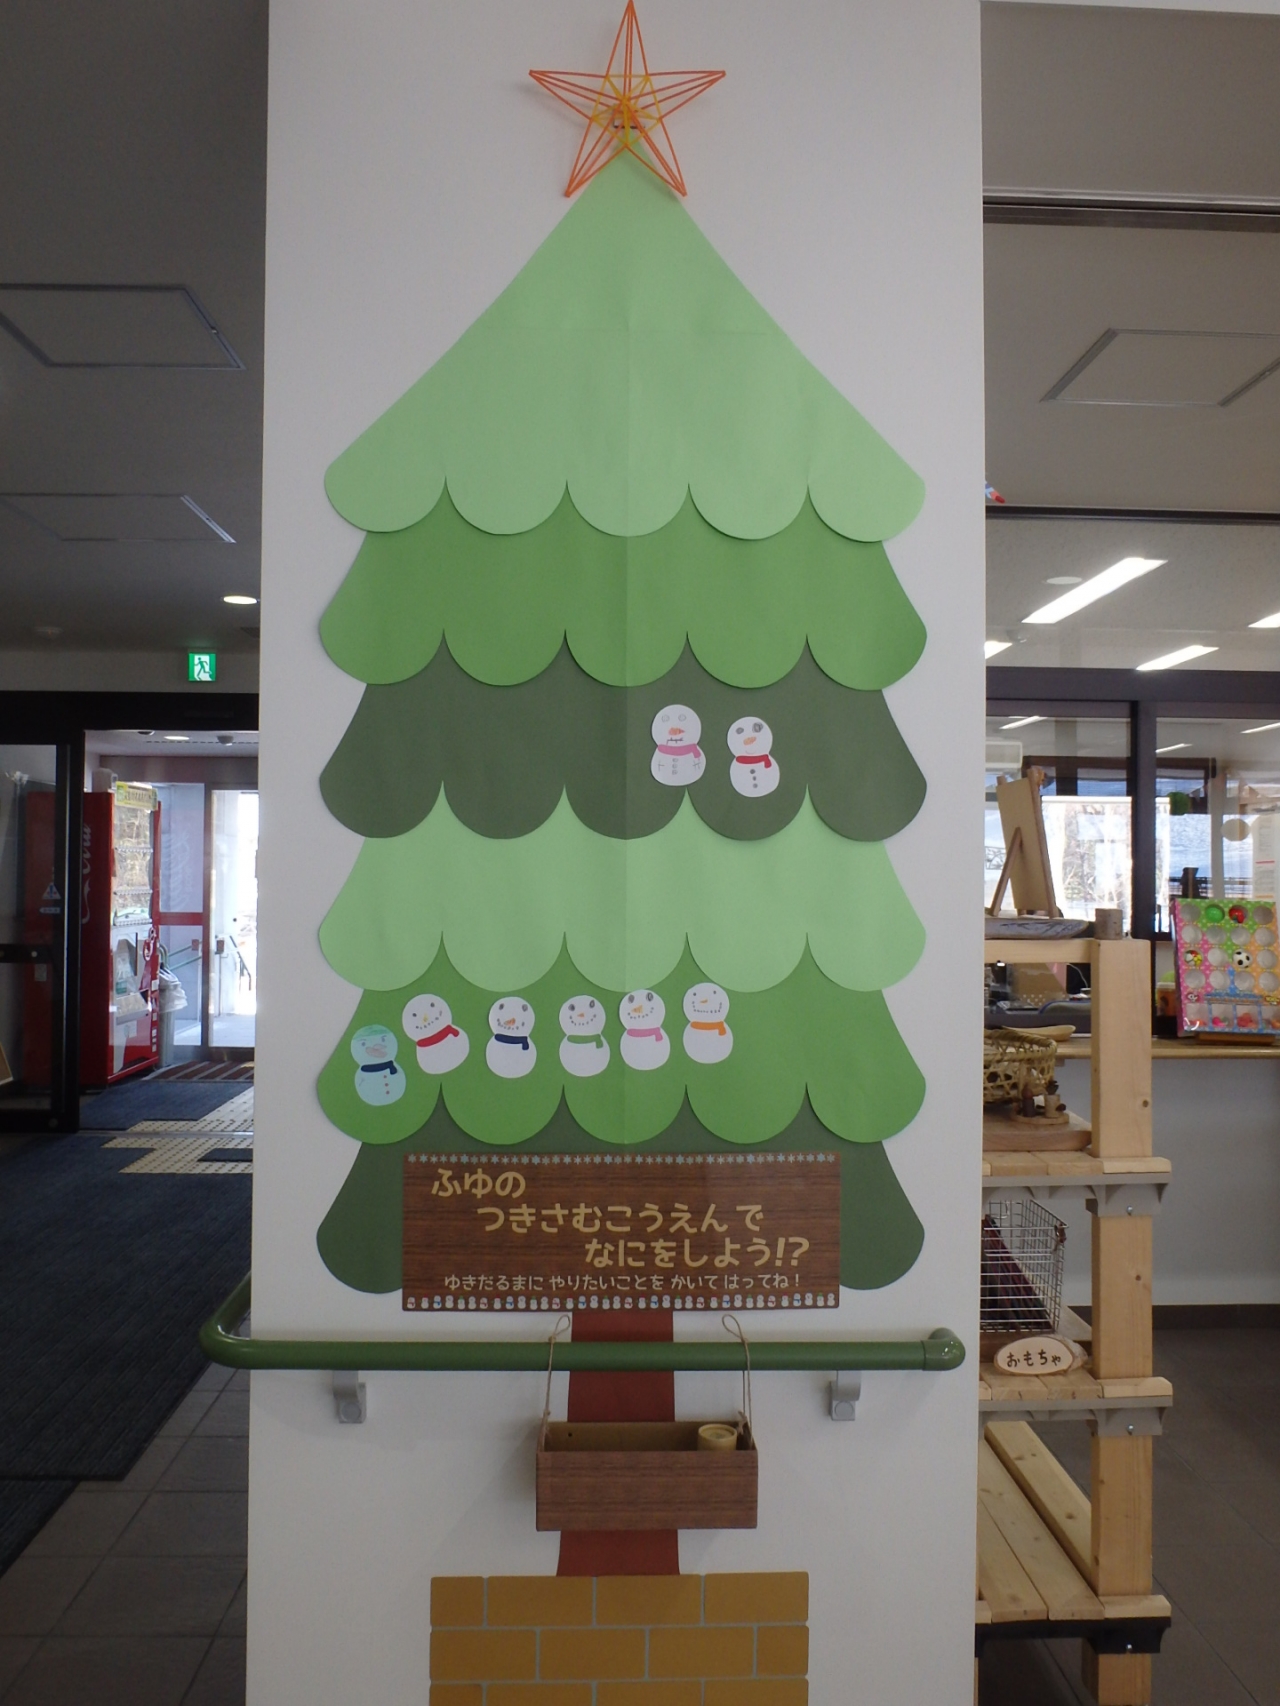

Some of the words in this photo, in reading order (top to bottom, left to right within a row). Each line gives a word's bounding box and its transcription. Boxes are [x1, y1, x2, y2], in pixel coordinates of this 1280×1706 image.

[431, 1167, 527, 1199] ふゆの
[584, 1236, 810, 1269] なにをしよう!?
[444, 1274, 544, 1291] ゆきだるまに
[548, 1274, 664, 1291] やりたいことを
[670, 1273, 719, 1290] かいて
[1006, 1348, 1062, 1368] おもちゃ
